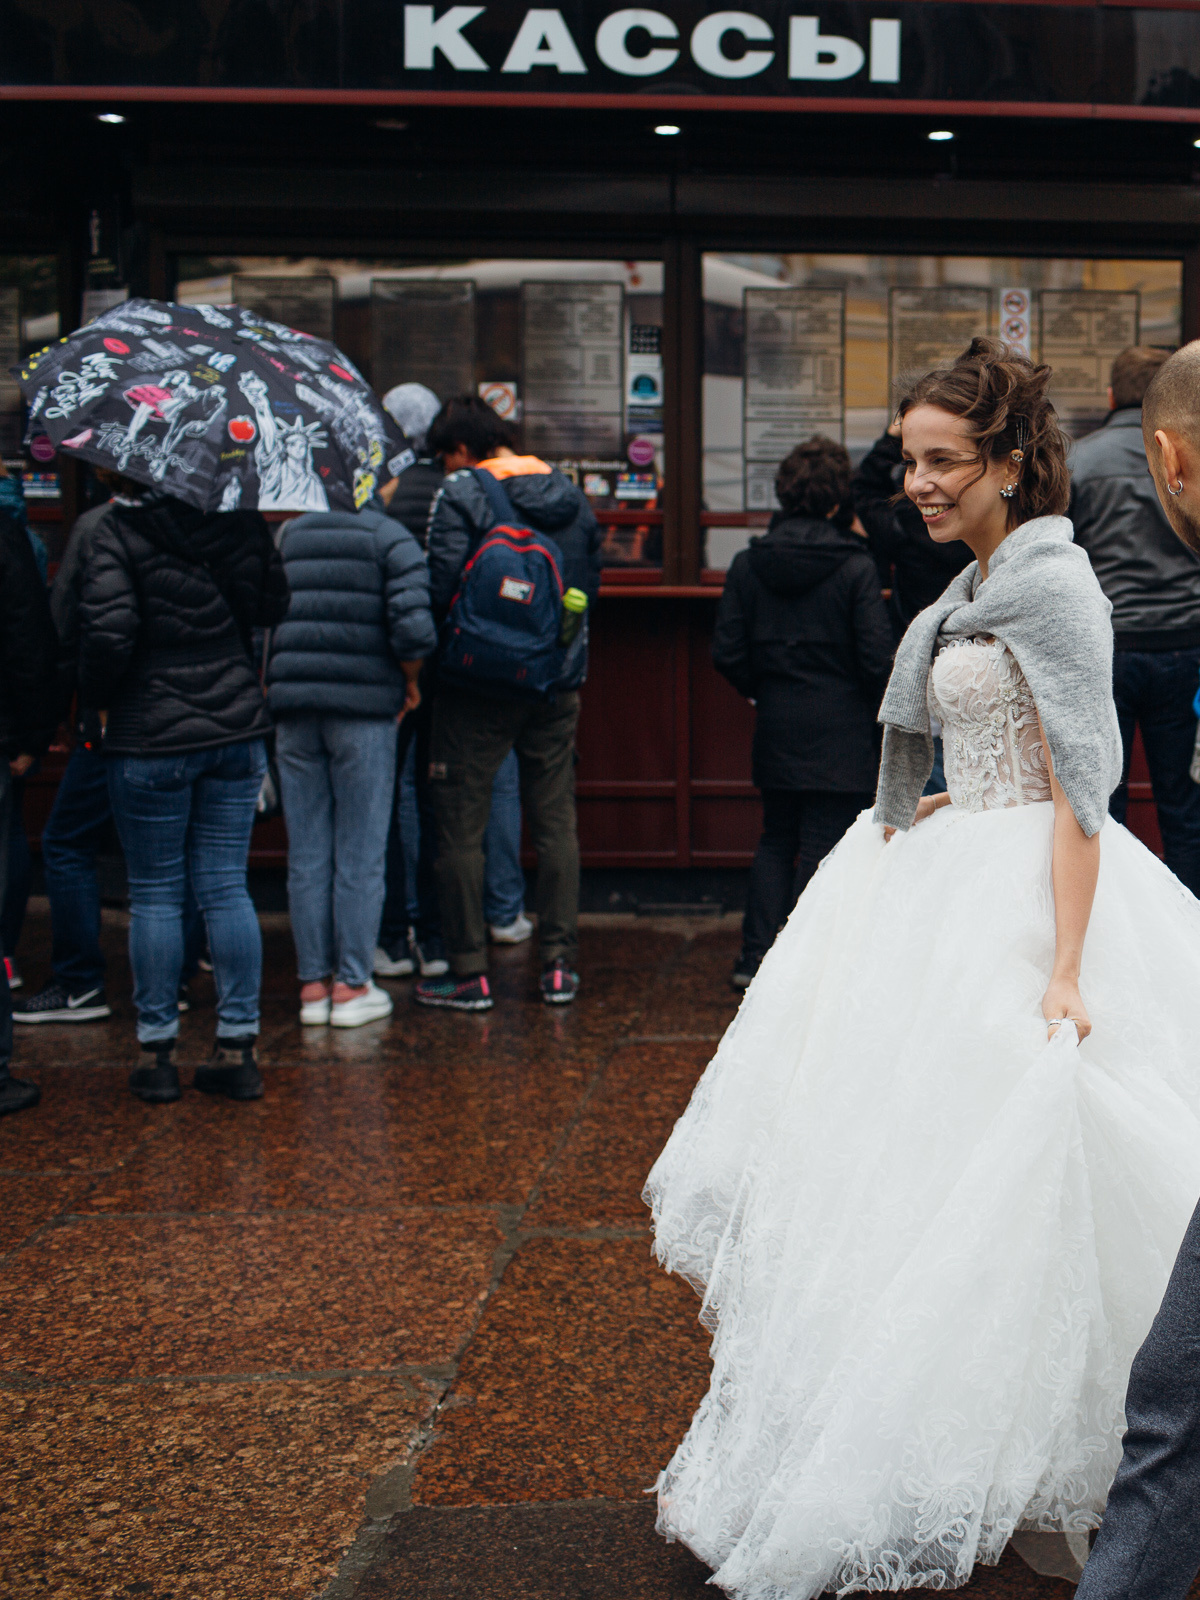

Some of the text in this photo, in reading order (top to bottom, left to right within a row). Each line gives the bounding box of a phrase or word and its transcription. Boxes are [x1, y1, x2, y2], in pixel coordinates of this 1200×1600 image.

[403, 4, 900, 83] КАССЫ
[58, 365, 110, 407] York
[82, 352, 125, 381] New
